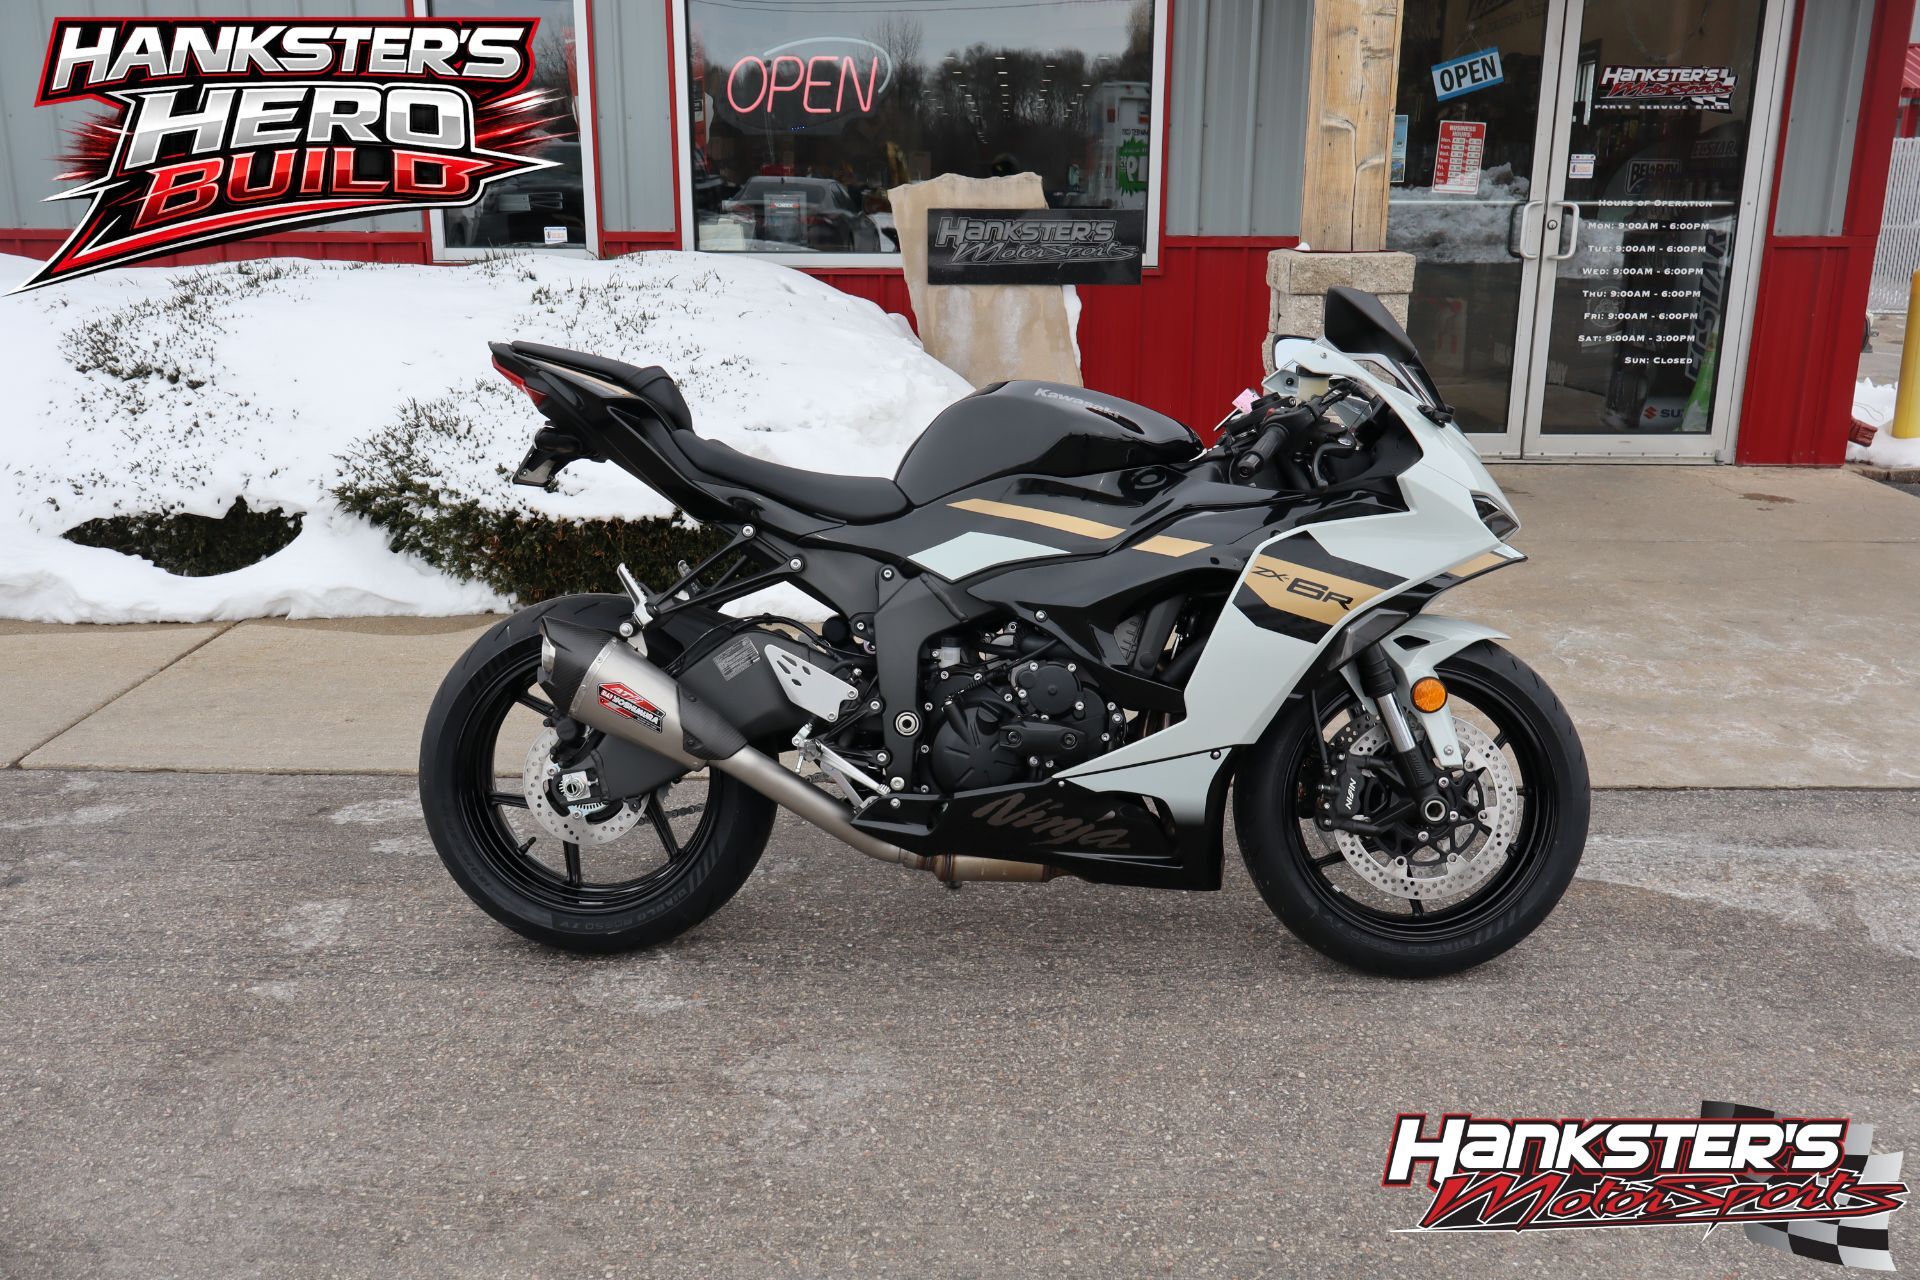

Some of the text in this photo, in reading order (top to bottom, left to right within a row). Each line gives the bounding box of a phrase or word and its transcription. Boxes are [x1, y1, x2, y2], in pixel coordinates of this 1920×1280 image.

[727, 55, 878, 113] OPEN
[1440, 55, 1497, 92] OPEN
[1618, 222, 1658, 230] 9:00AM
[1669, 222, 1709, 230] 6:00PM
[1615, 245, 1655, 253] 9:00AM
[1667, 245, 1706, 253] 6:00PM
[1610, 290, 1650, 298] 9:00AM
[1661, 290, 1701, 298] 6:00PM
[1034, 387, 1121, 419] Kawasaki
[971, 792, 1131, 849] Ninja
